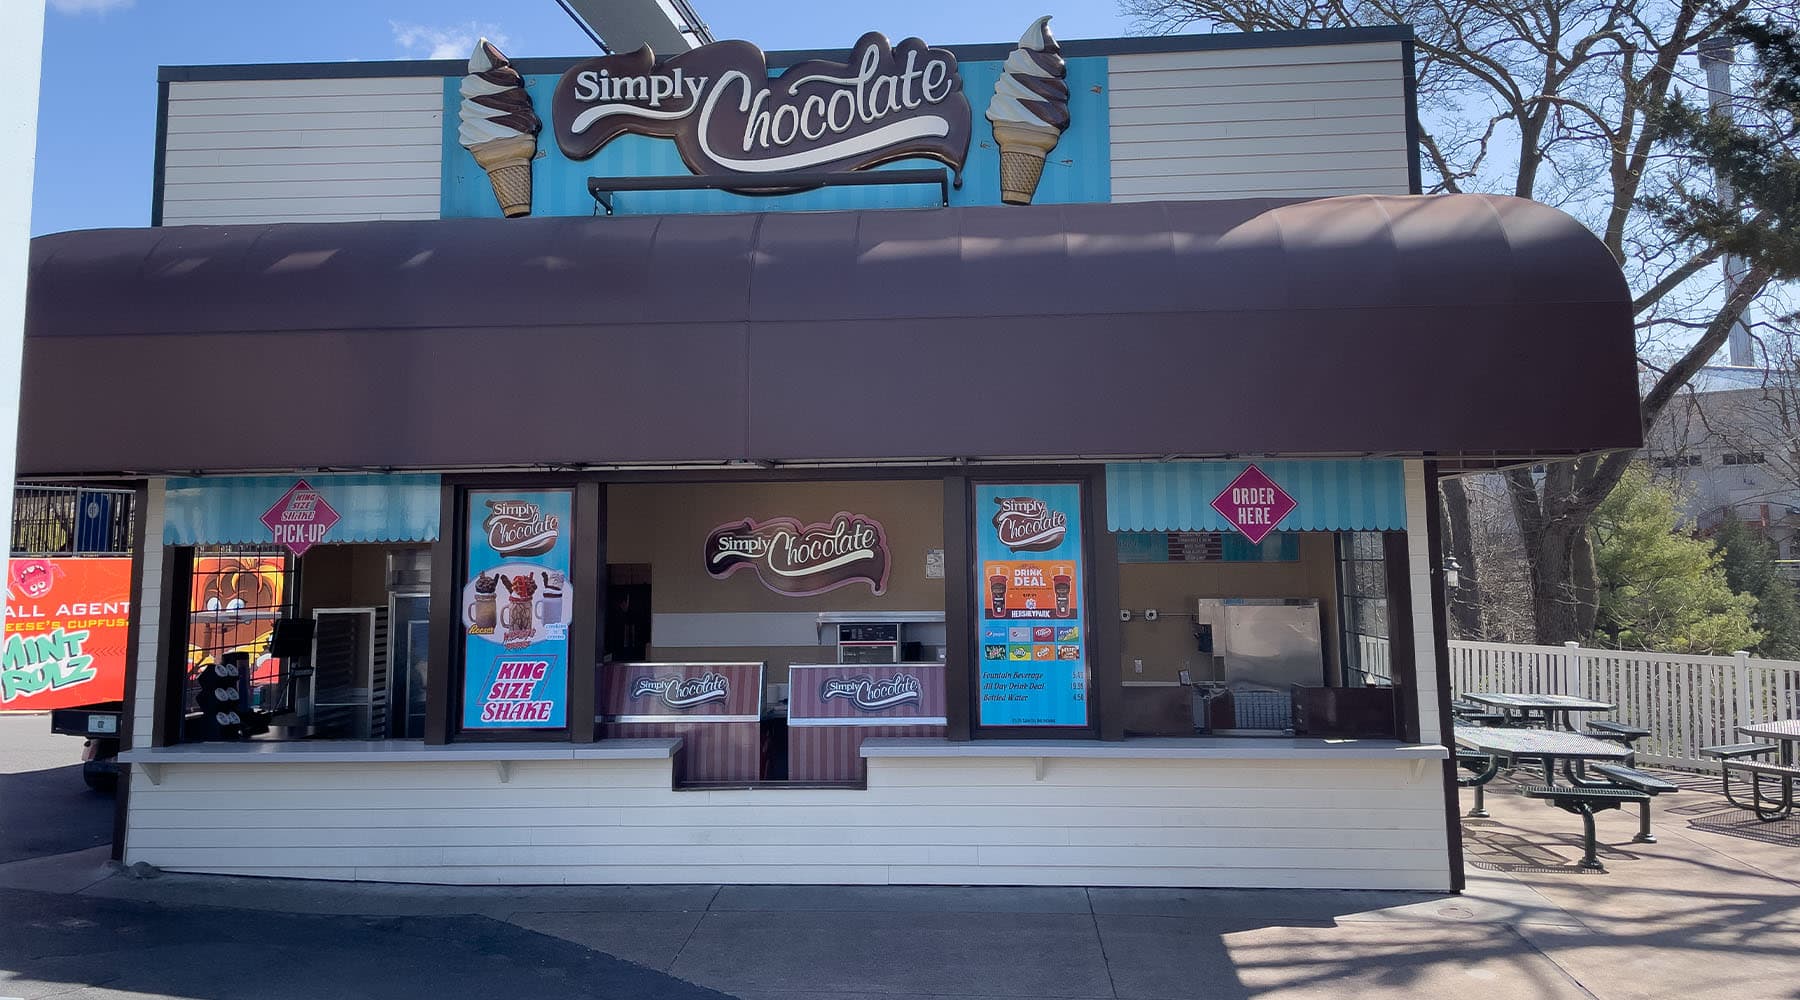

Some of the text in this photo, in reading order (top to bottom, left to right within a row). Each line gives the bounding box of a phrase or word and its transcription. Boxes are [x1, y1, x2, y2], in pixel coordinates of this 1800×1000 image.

[573, 42, 953, 172] Simply Chocolate
[1232, 488, 1275, 505] ORDER
[291, 502, 311, 510] SIZE
[494, 503, 537, 517] Simply
[1002, 499, 1044, 515] Simply
[281, 511, 315, 521] SHAKE
[1238, 507, 1271, 525] HERE
[274, 524, 326, 543] PICK-UP
[489, 513, 558, 551] Chocolate
[998, 509, 1066, 546] Chocolate
[718, 520, 876, 576] Simply Chocolate
[1014, 569, 1042, 577] DRINK
[1014, 577, 1047, 587] DEAL
[5, 605, 46, 618] ALL
[1011, 610, 1051, 618] HERSHEYPARK
[5, 621, 61, 632] EESE'S
[1, 628, 89, 671] MINT
[1, 655, 95, 701] RULZ
[498, 662, 546, 680] KING
[1013, 672, 1043, 681] Beverage
[489, 683, 534, 700] SIZE
[639, 674, 727, 705] Simply Chocolate
[829, 673, 918, 707] Simply Chocolate
[995, 683, 1006, 691] Day
[482, 702, 552, 721] SHAKE
